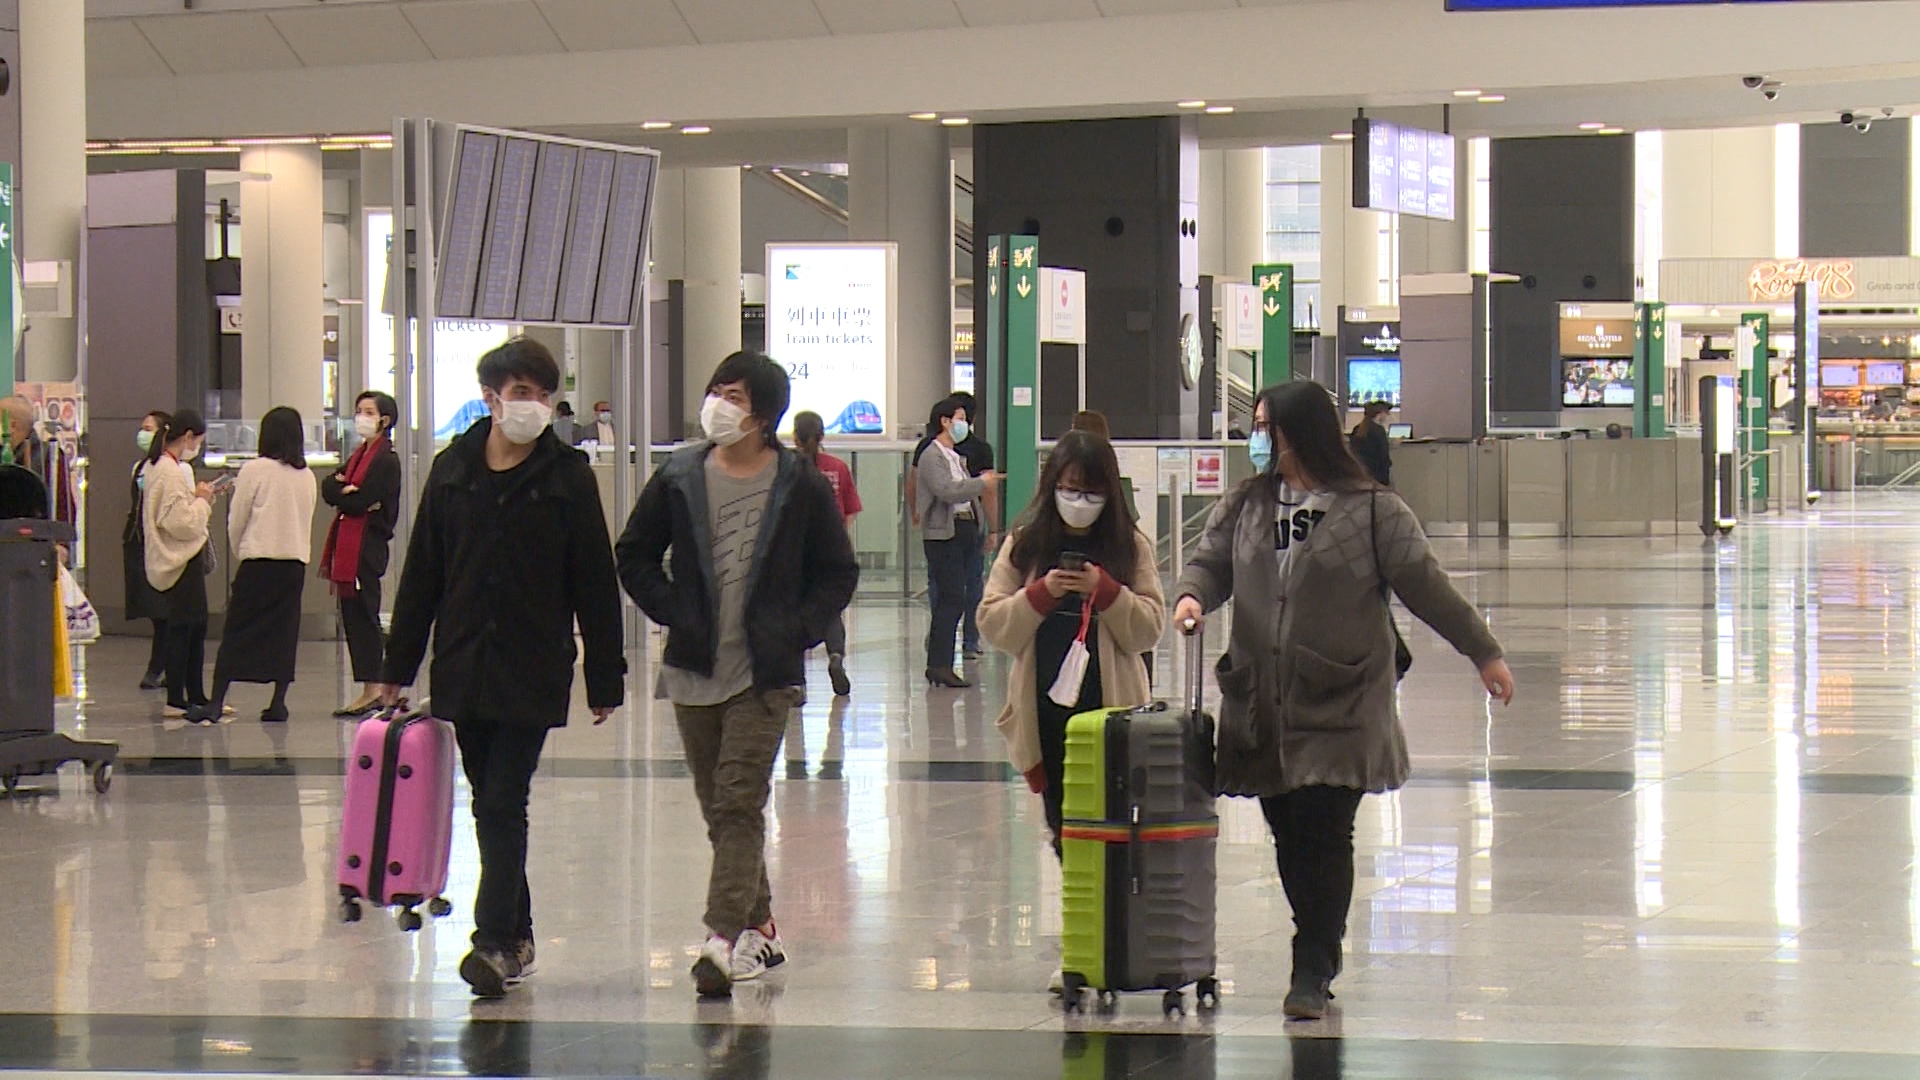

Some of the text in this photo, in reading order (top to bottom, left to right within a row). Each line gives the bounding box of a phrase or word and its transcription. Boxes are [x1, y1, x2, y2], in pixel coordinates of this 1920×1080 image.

[1894, 280, 1915, 290] and
[787, 332, 873, 344] Train tickets
[786, 361, 809, 380] 24
